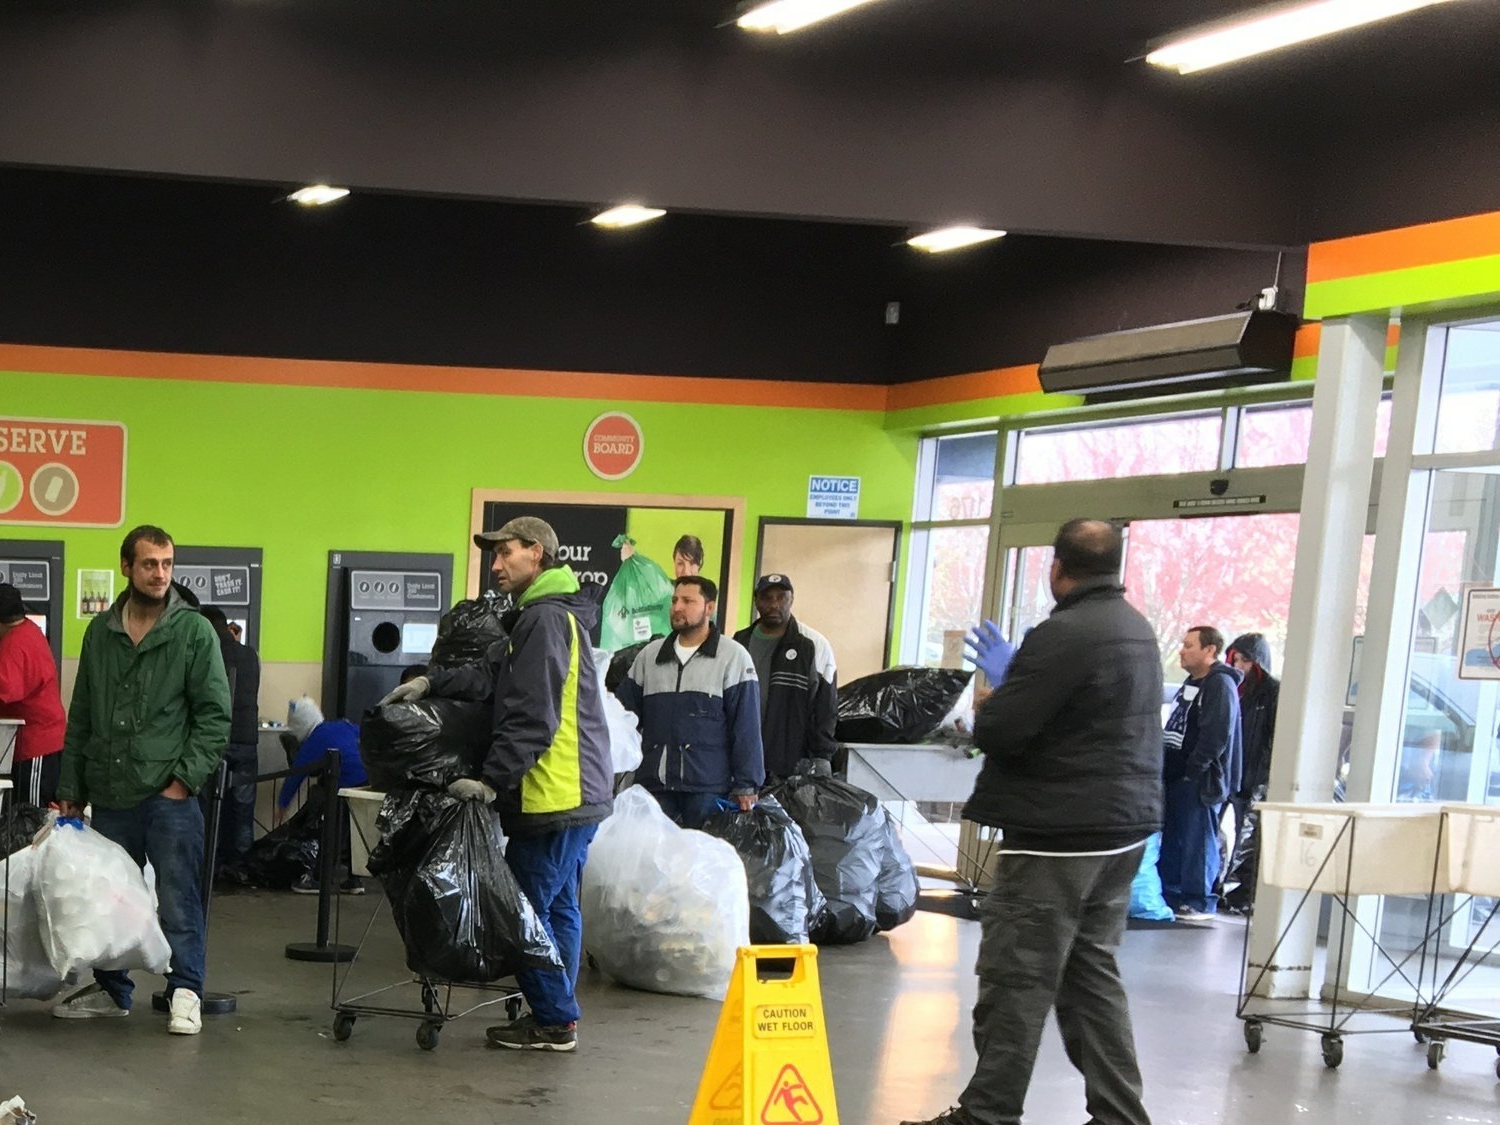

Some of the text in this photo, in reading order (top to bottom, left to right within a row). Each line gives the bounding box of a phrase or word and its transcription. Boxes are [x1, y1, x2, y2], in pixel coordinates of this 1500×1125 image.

[594, 434, 635, 443] COMMUNITY
[594, 443, 635, 455] BOARD
[811, 479, 857, 492] NOTICE
[558, 545, 592, 561] our
[216, 580, 234, 590] TRASH
[216, 587, 232, 596] CASH
[762, 1008, 807, 1019] CAUTION
[757, 1021, 814, 1032] WET FLOOR
